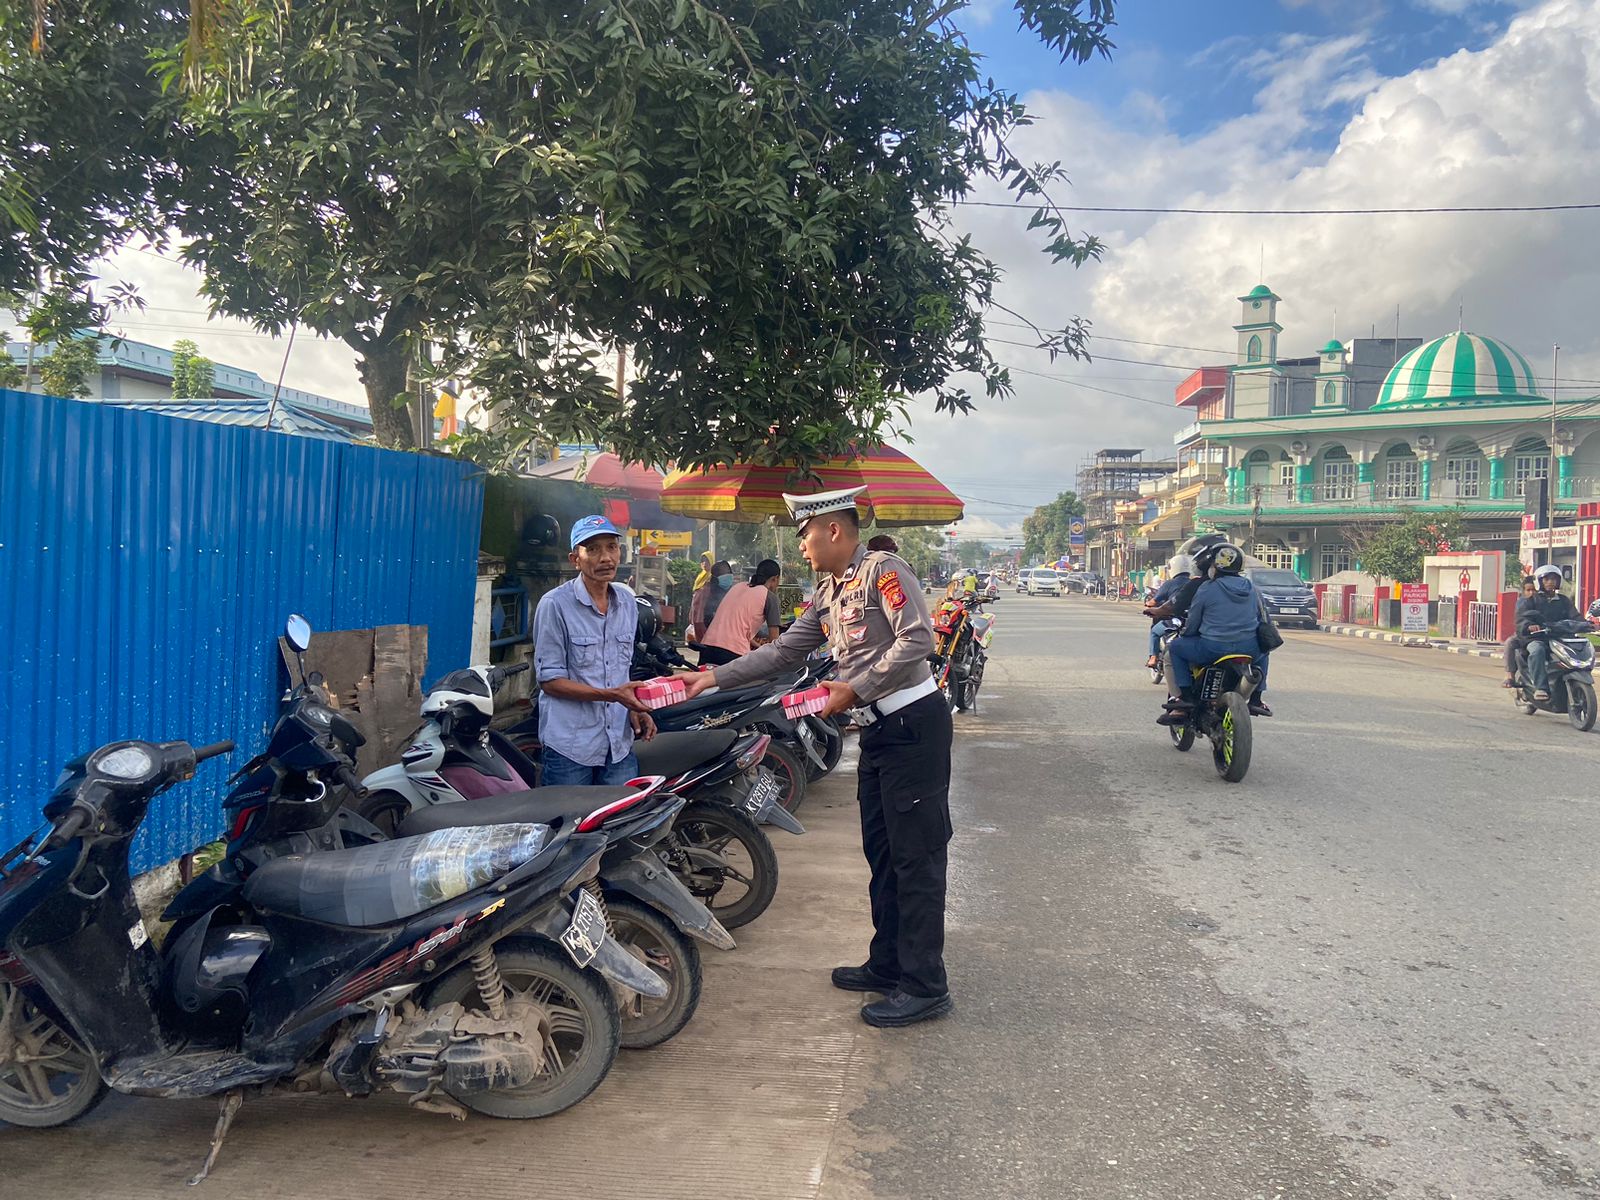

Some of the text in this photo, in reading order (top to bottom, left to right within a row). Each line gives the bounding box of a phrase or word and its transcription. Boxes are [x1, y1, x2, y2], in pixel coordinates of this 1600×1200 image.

[752, 782, 768, 803] 2973
[745, 797, 763, 812] KT
[577, 903, 594, 932] 2757
